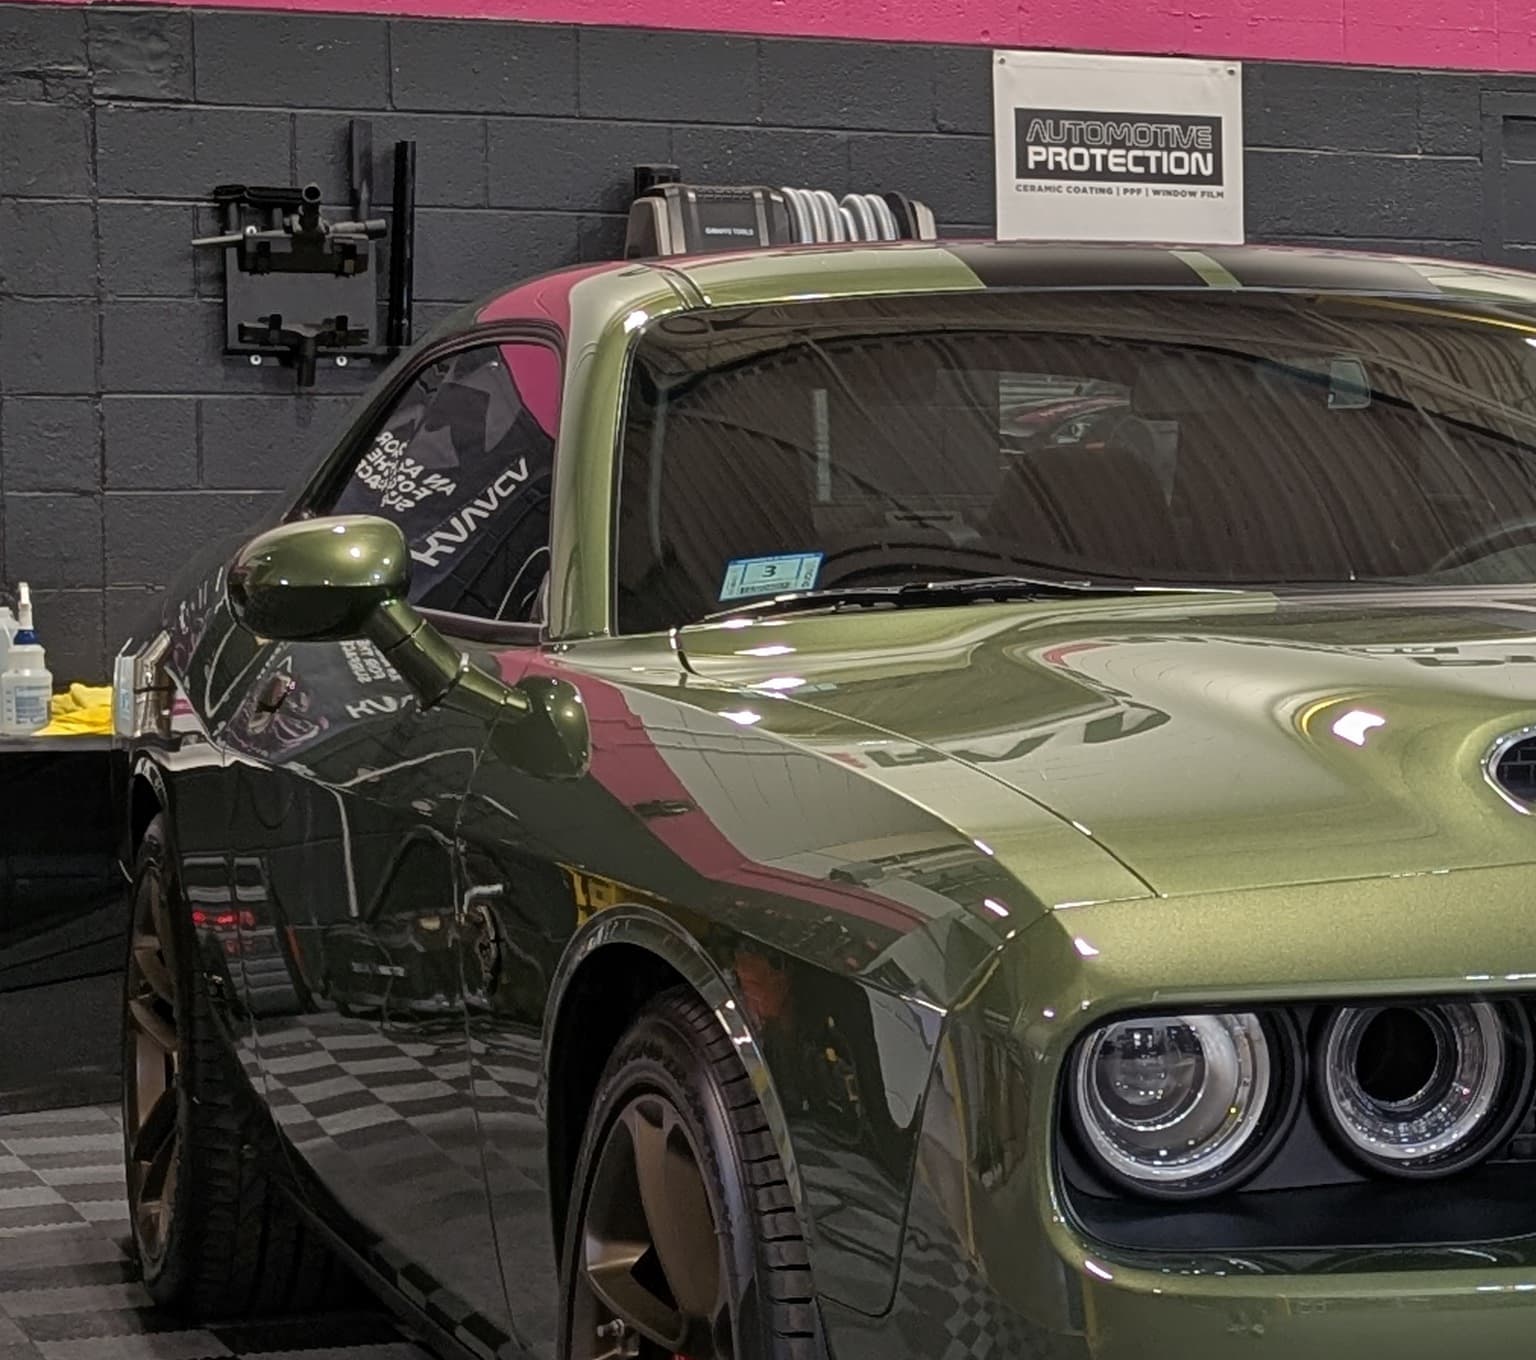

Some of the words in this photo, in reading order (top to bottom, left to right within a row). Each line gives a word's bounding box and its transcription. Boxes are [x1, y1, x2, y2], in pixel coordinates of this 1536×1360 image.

[1026, 118, 1213, 150] AUTOMOTIVE
[1027, 146, 1213, 176] PROTECTION
[1015, 184, 1064, 195] CERAMIC
[1066, 185, 1114, 196] COATING
[1123, 187, 1143, 197] PPF
[1152, 188, 1198, 199] WINDOW
[1200, 190, 1225, 200] FILM
[762, 565, 777, 578] 3
